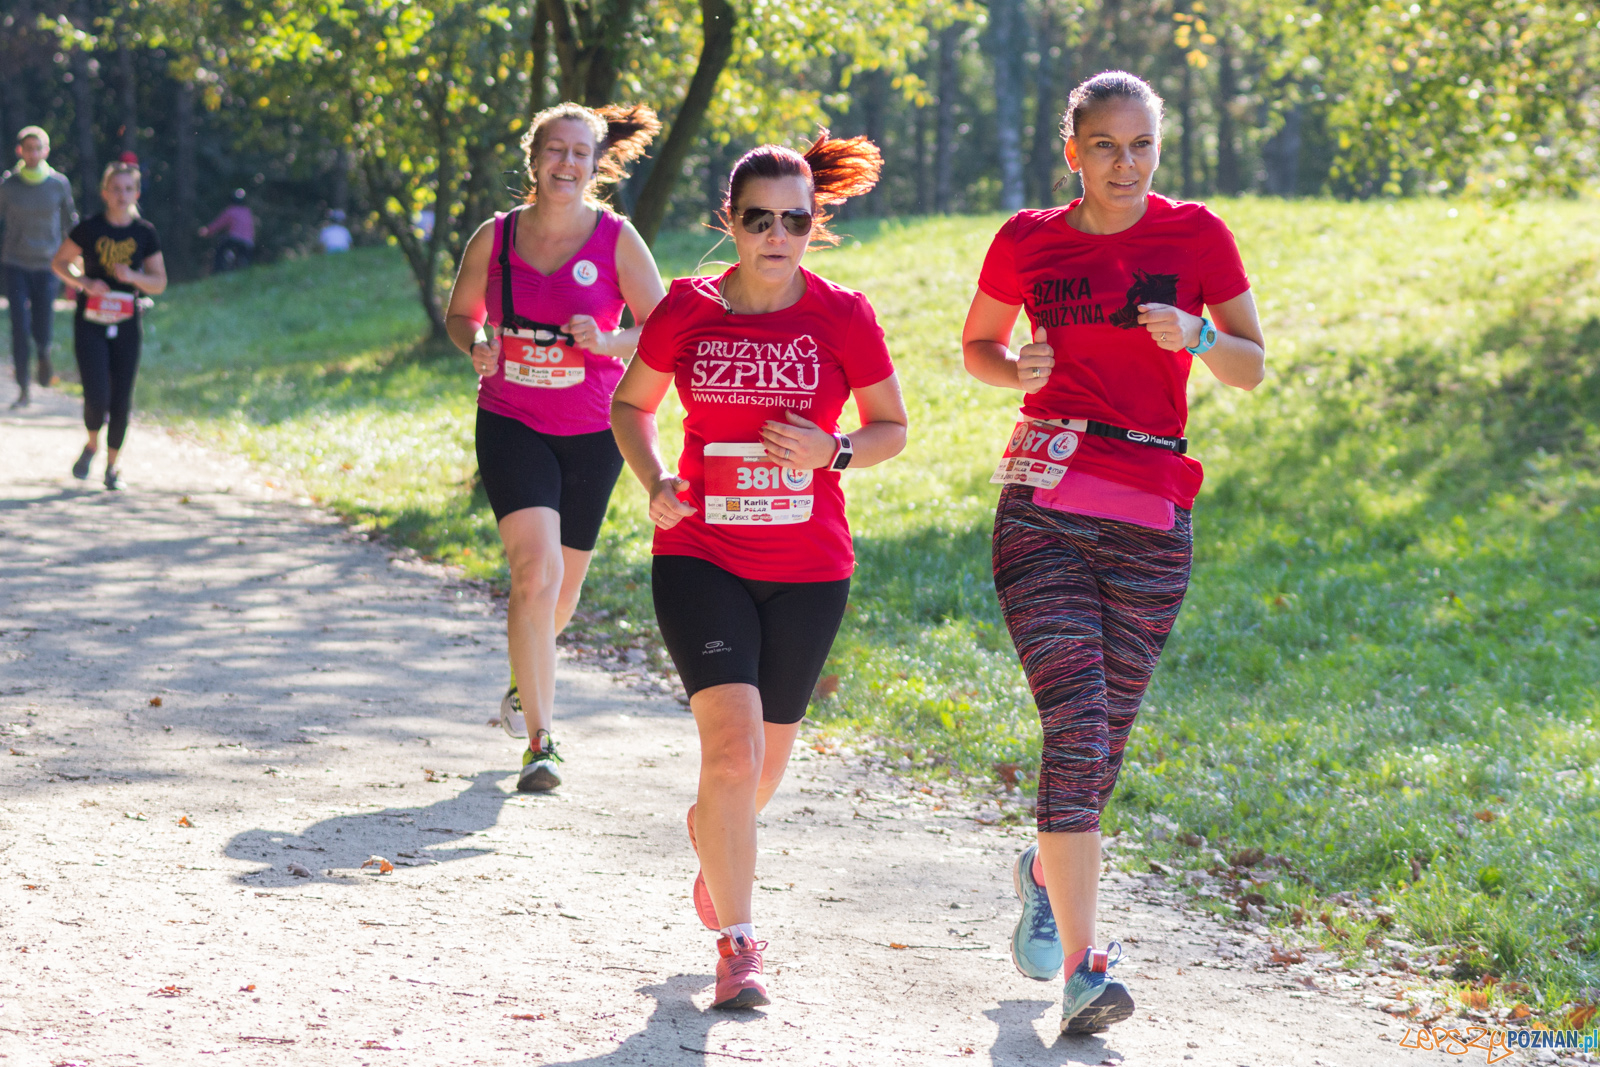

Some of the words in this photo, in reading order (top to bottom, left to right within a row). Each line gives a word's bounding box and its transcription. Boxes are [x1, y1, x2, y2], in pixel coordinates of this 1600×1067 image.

[1033, 276, 1092, 306] DZIKA
[522, 345, 564, 363] 250
[696, 338, 798, 361] DRUŻYNA
[690, 360, 820, 390] SZPIKU
[692, 392, 812, 410] www.darszpiku.pl
[1022, 430, 1050, 452] 87
[736, 466, 780, 490] 381
